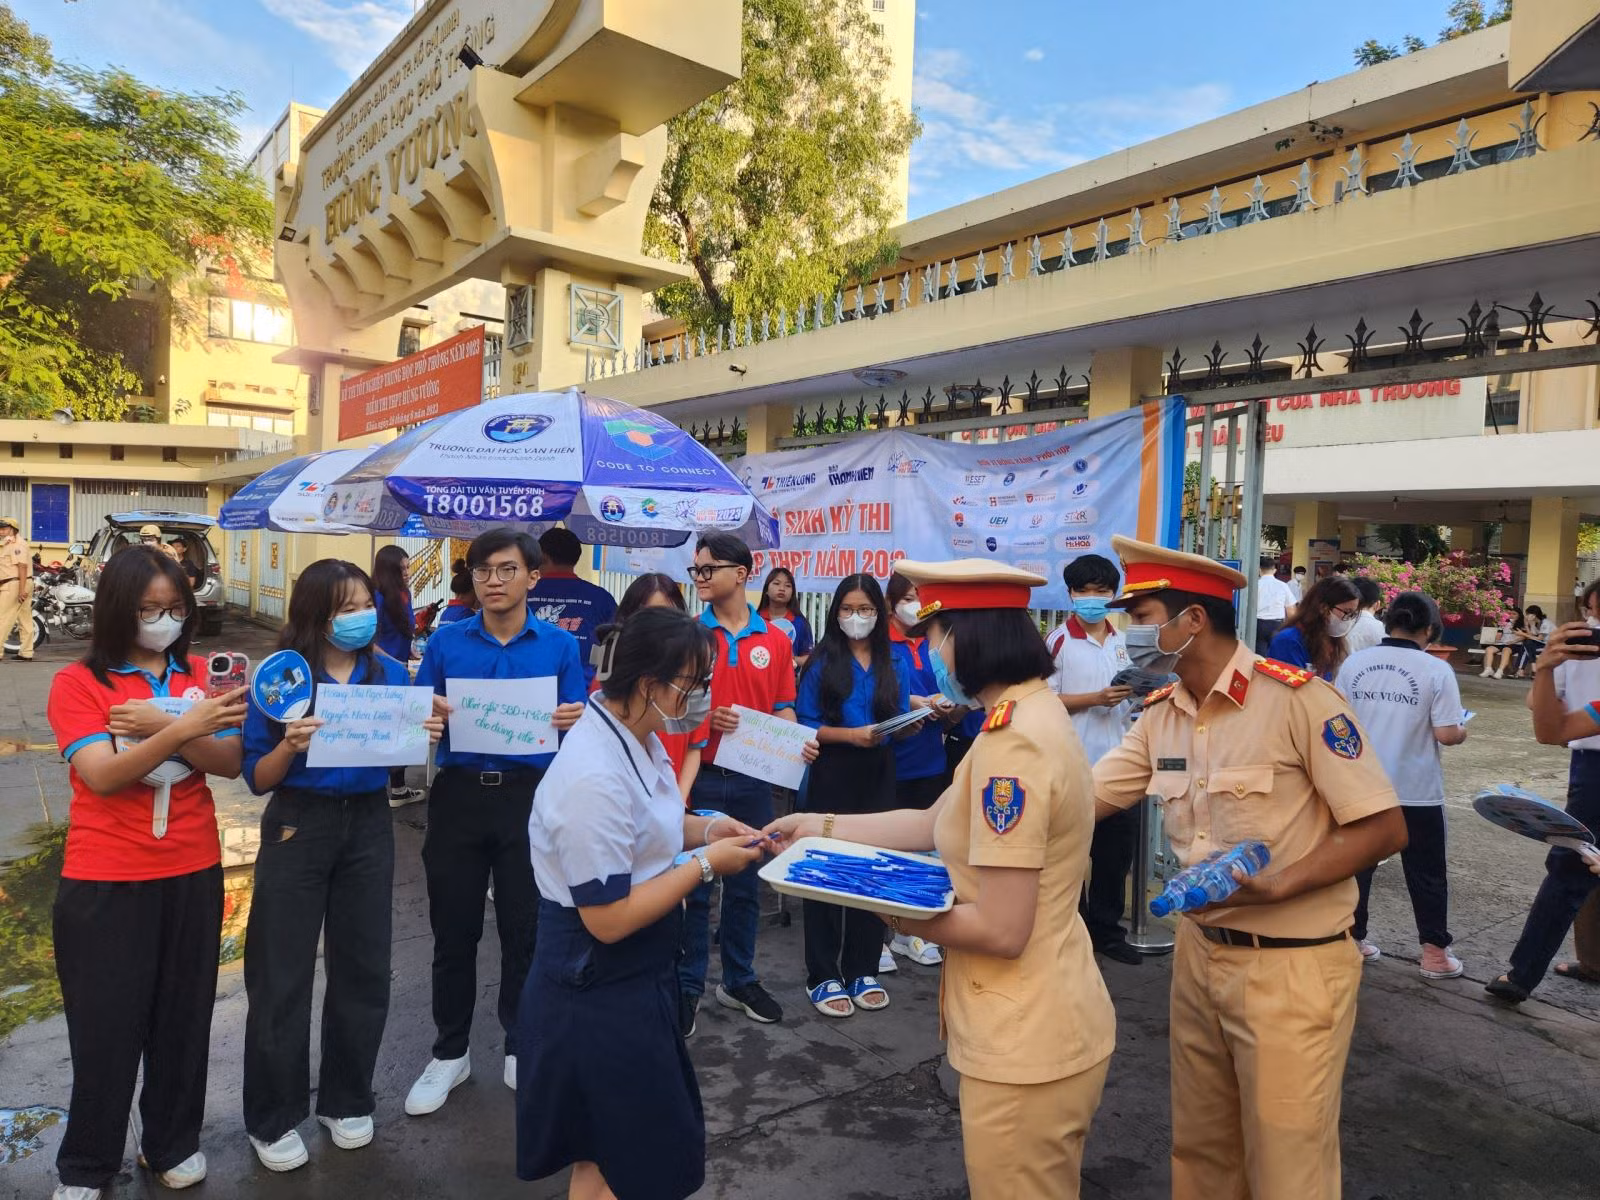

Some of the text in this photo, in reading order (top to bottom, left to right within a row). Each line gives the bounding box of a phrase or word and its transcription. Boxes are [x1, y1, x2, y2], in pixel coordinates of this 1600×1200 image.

[325, 163, 381, 245] HÙNG
[596, 460, 718, 477] CODE TO CONNECT
[525, 487, 545, 495] SINH
[423, 494, 544, 517] 18001568
[718, 508, 742, 521] 2023
[785, 506, 827, 536] SINH
[829, 498, 856, 533] KỲ
[858, 501, 892, 533] THI
[989, 516, 1009, 525] UEH
[768, 550, 812, 578] THPT
[814, 544, 857, 578] NĂM
[1379, 691, 1419, 706] VƯƠNG
